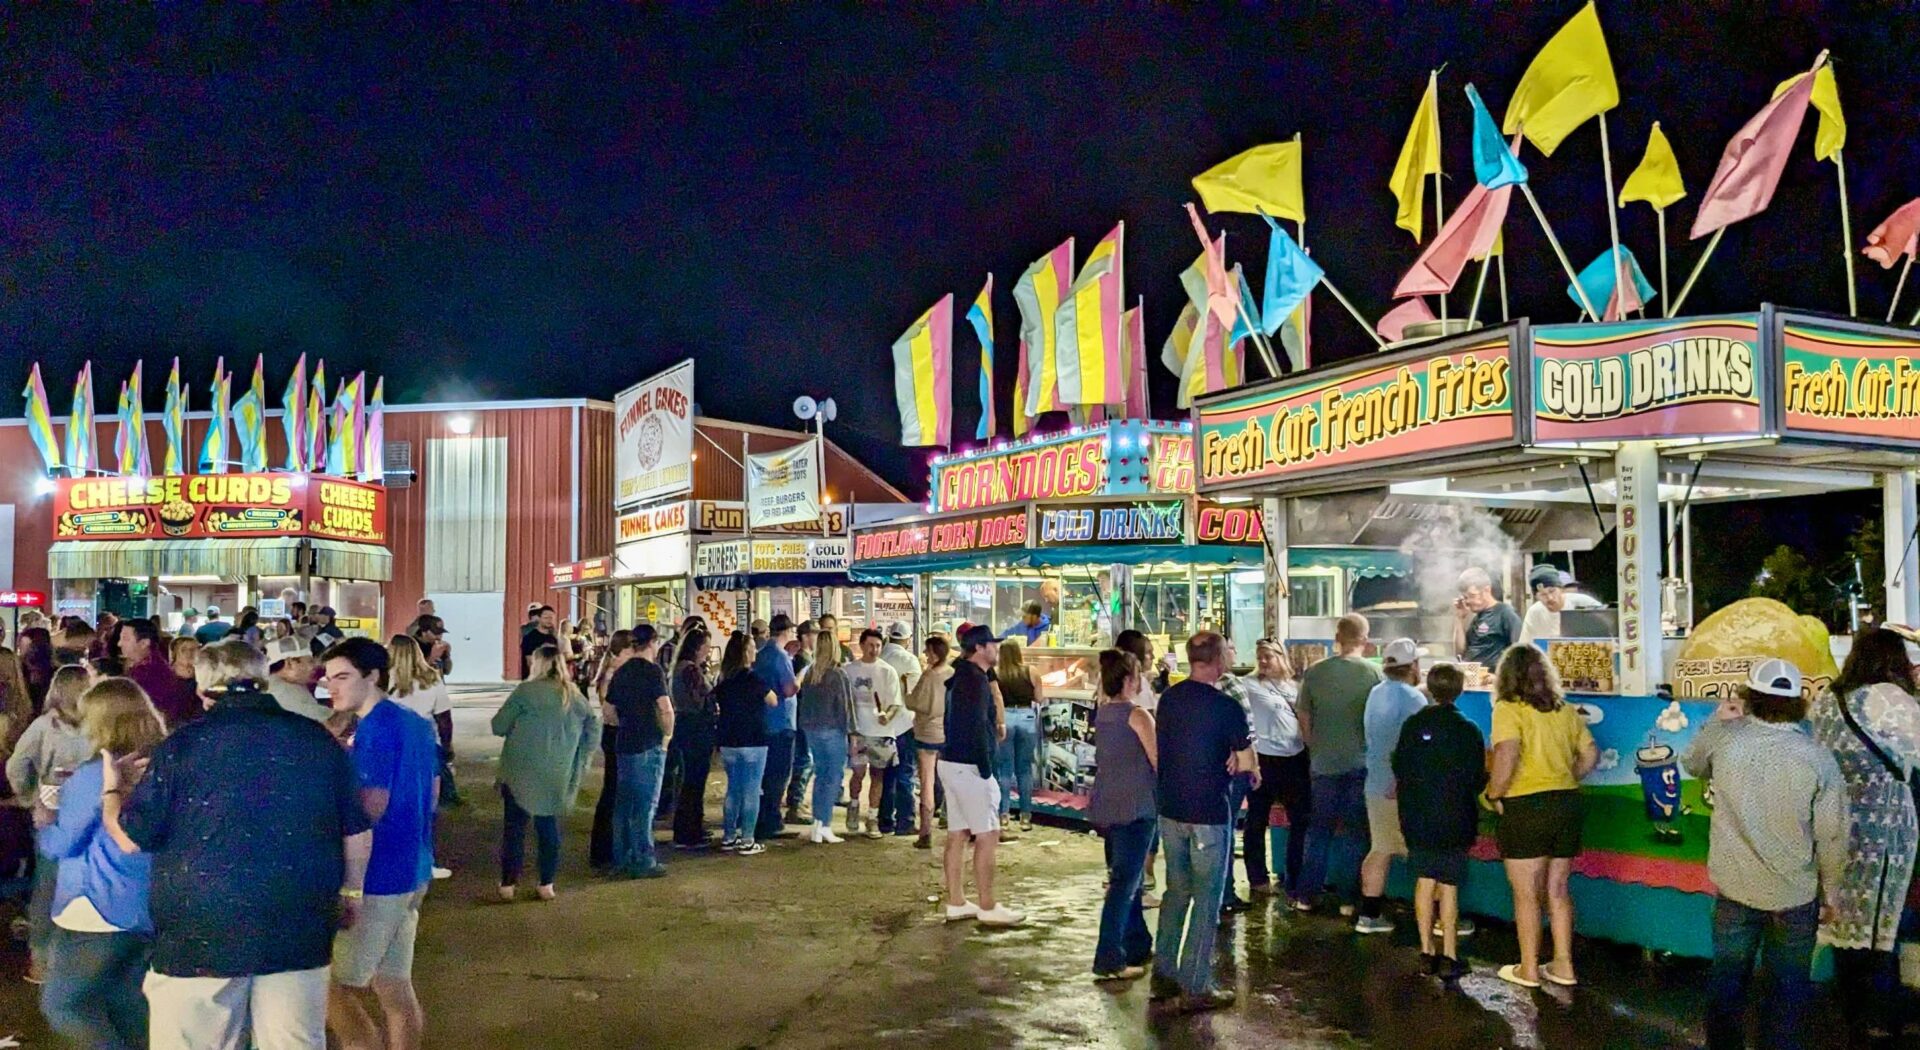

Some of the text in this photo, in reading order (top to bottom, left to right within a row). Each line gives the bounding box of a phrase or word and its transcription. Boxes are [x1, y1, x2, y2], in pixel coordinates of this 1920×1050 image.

[1541, 337, 1754, 420] COLD DRINKS
[1785, 359, 1848, 418] Fresh
[1851, 357, 1893, 420] Cut
[620, 387, 688, 442] FUNNEL CAKES
[1203, 355, 1509, 478] Fresh Cut French Fries
[941, 436, 1102, 512] CORNDOGS
[70, 476, 292, 510] CHEESE CURDS
[320, 482, 376, 511] CHEESE
[776, 491, 806, 504] BURGERS
[323, 506, 372, 532] CURDS
[620, 505, 684, 538] FUNNEL CAKES
[1041, 507, 1182, 541] COLD DRINKS
[754, 543, 775, 555] TOTS
[782, 543, 806, 555] FRIES
[816, 545, 845, 556] COLD
[854, 513, 1027, 560] FOOTLONG CORN DOGS
[708, 544, 738, 571] BURGERS
[754, 557, 807, 570] BURGERS
[1622, 504, 1639, 671] BUCKET
[1675, 658, 1711, 678] FRESH
